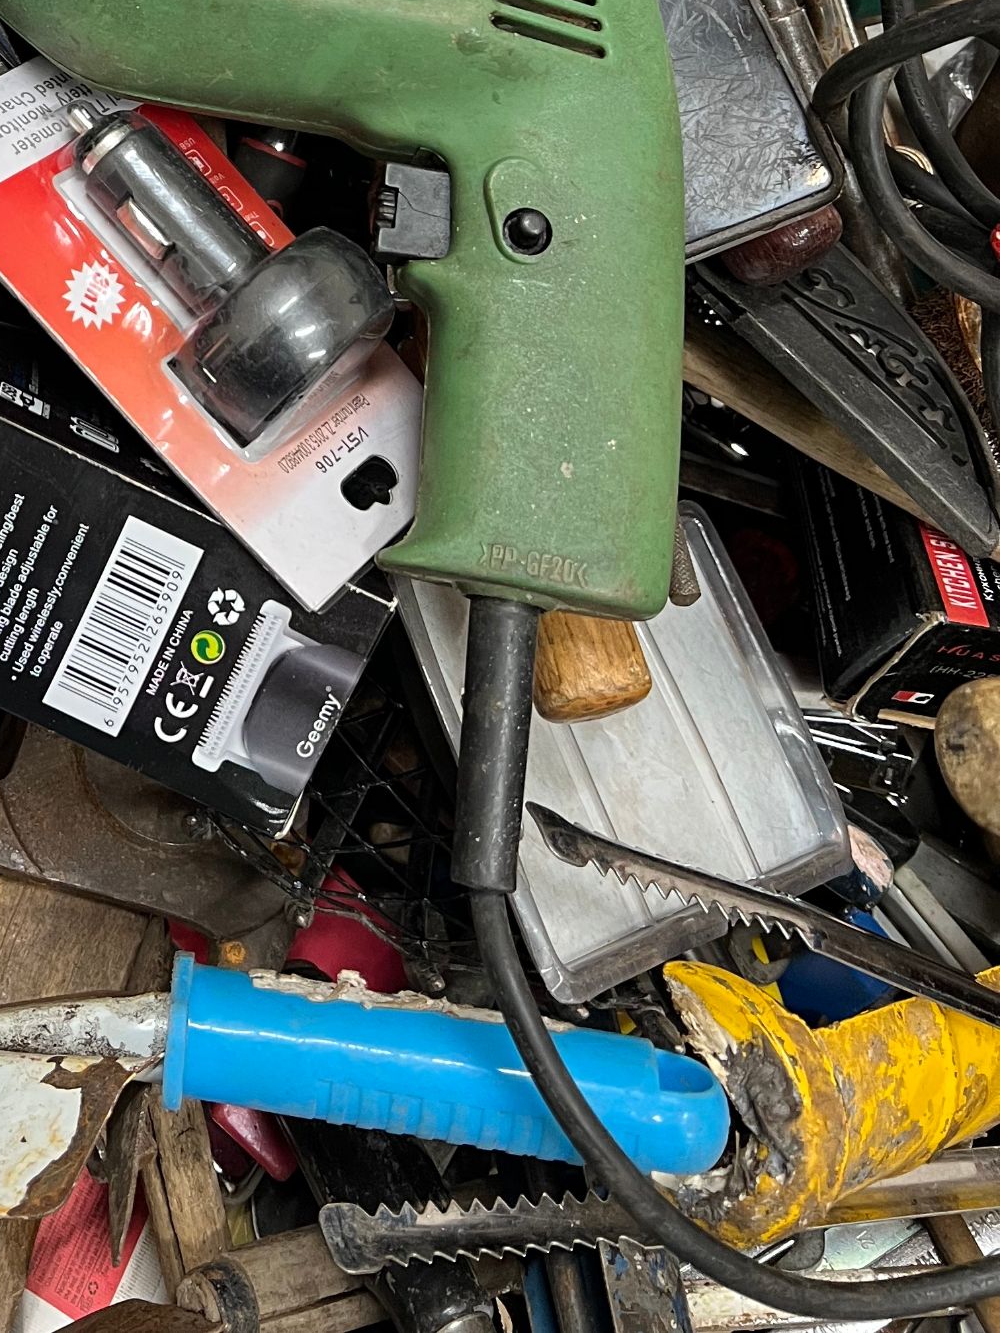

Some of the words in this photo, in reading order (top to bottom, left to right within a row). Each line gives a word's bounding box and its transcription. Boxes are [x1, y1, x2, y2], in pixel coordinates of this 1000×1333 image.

[56, 83, 93, 107] ttery
[314, 425, 370, 474] VST-706
[2, 583, 23, 616] blade
[17, 524, 51, 585] adjustable
[43, 504, 59, 525] for
[933, 549, 978, 610] KITCHEN
[0, 624, 25, 663] cutting
[18, 587, 40, 627] length
[12, 643, 33, 674] Used
[29, 523, 90, 645] wirelessly,convenient
[29, 664, 43, 678] to
[38, 620, 64, 665] operate
[145, 660, 170, 696] MADE
[162, 646, 176, 662] IN
[169, 609, 194, 647] CHINA
[296, 692, 342, 758] Geemy
